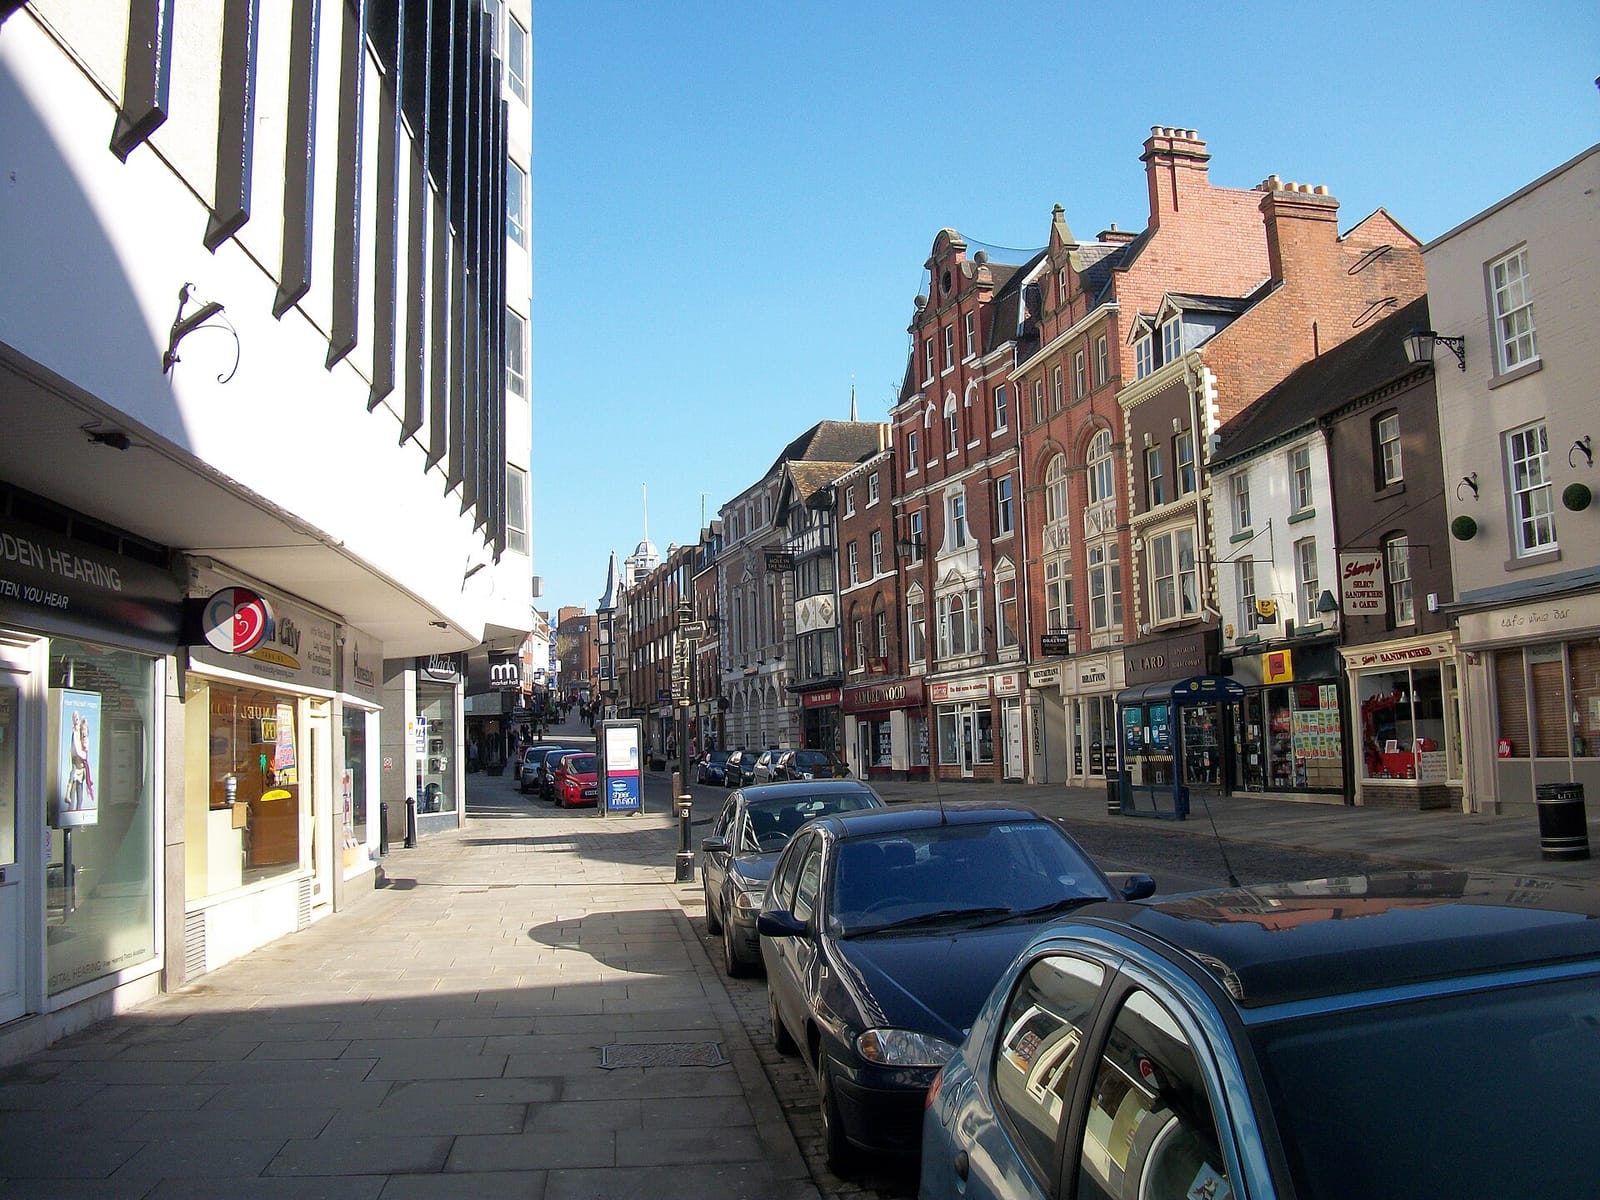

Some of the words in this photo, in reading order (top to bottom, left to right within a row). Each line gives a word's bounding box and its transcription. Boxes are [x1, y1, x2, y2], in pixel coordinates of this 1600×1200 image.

[0, 533, 43, 569] DEN
[48, 547, 122, 592] HEARING
[1353, 580, 1374, 588] SELECT
[24, 585, 43, 603] YOU
[44, 592, 69, 609] HEAR
[1359, 600, 1378, 608] CAKES
[278, 616, 301, 655] City
[1380, 647, 1432, 662] SANDWICHES
[428, 655, 456, 674] Blacks
[855, 689, 881, 705] SAMUEL
[883, 685, 906, 701] WOOD
[73, 961, 102, 977] HEARING
